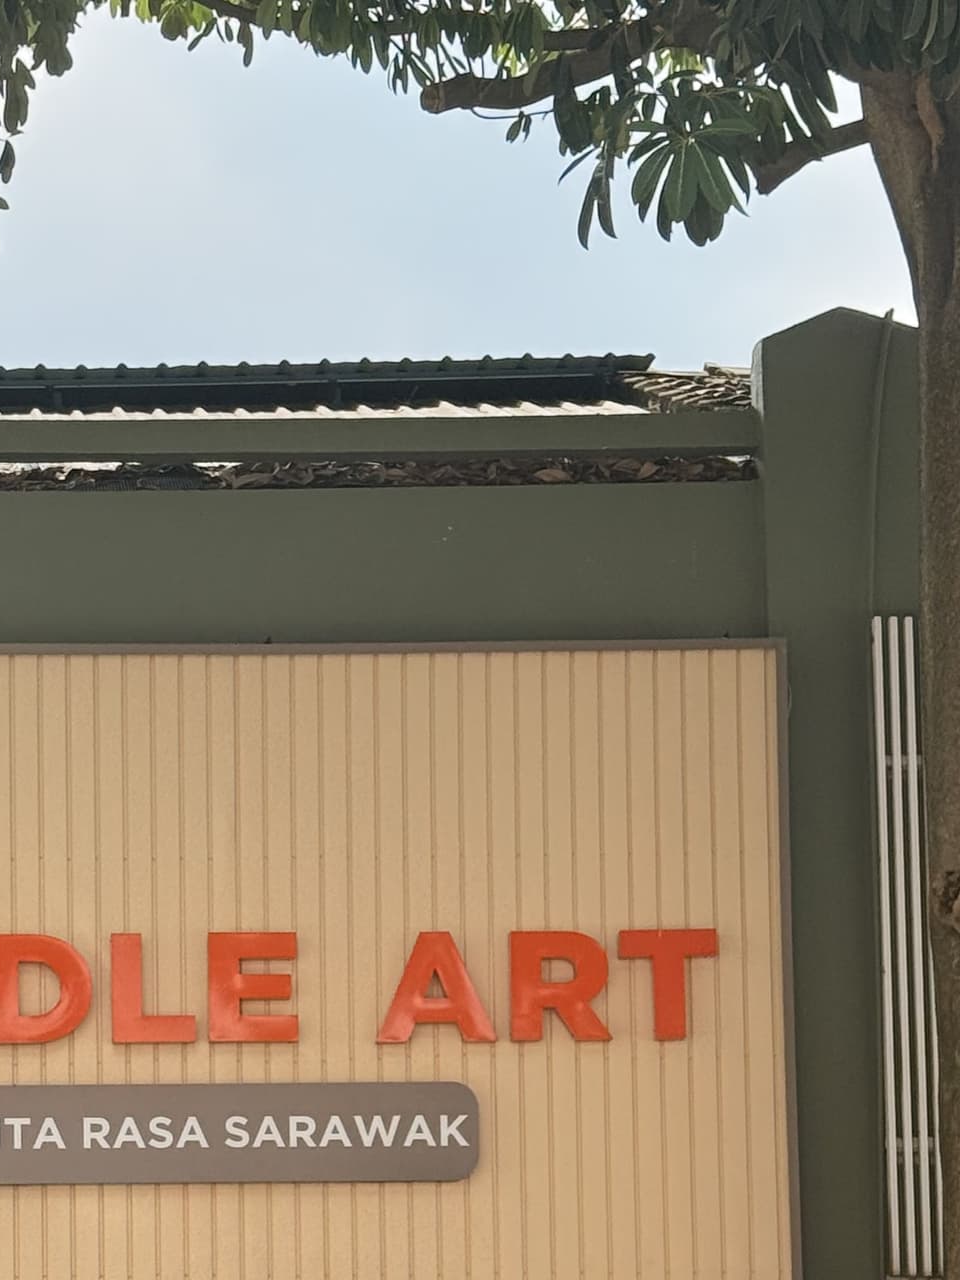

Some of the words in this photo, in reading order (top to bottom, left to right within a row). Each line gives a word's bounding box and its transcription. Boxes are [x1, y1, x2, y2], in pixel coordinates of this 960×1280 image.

[376, 928, 719, 1044] ART
[83, 1115, 210, 1149] RASA
[224, 1113, 470, 1148] SARAWAK
